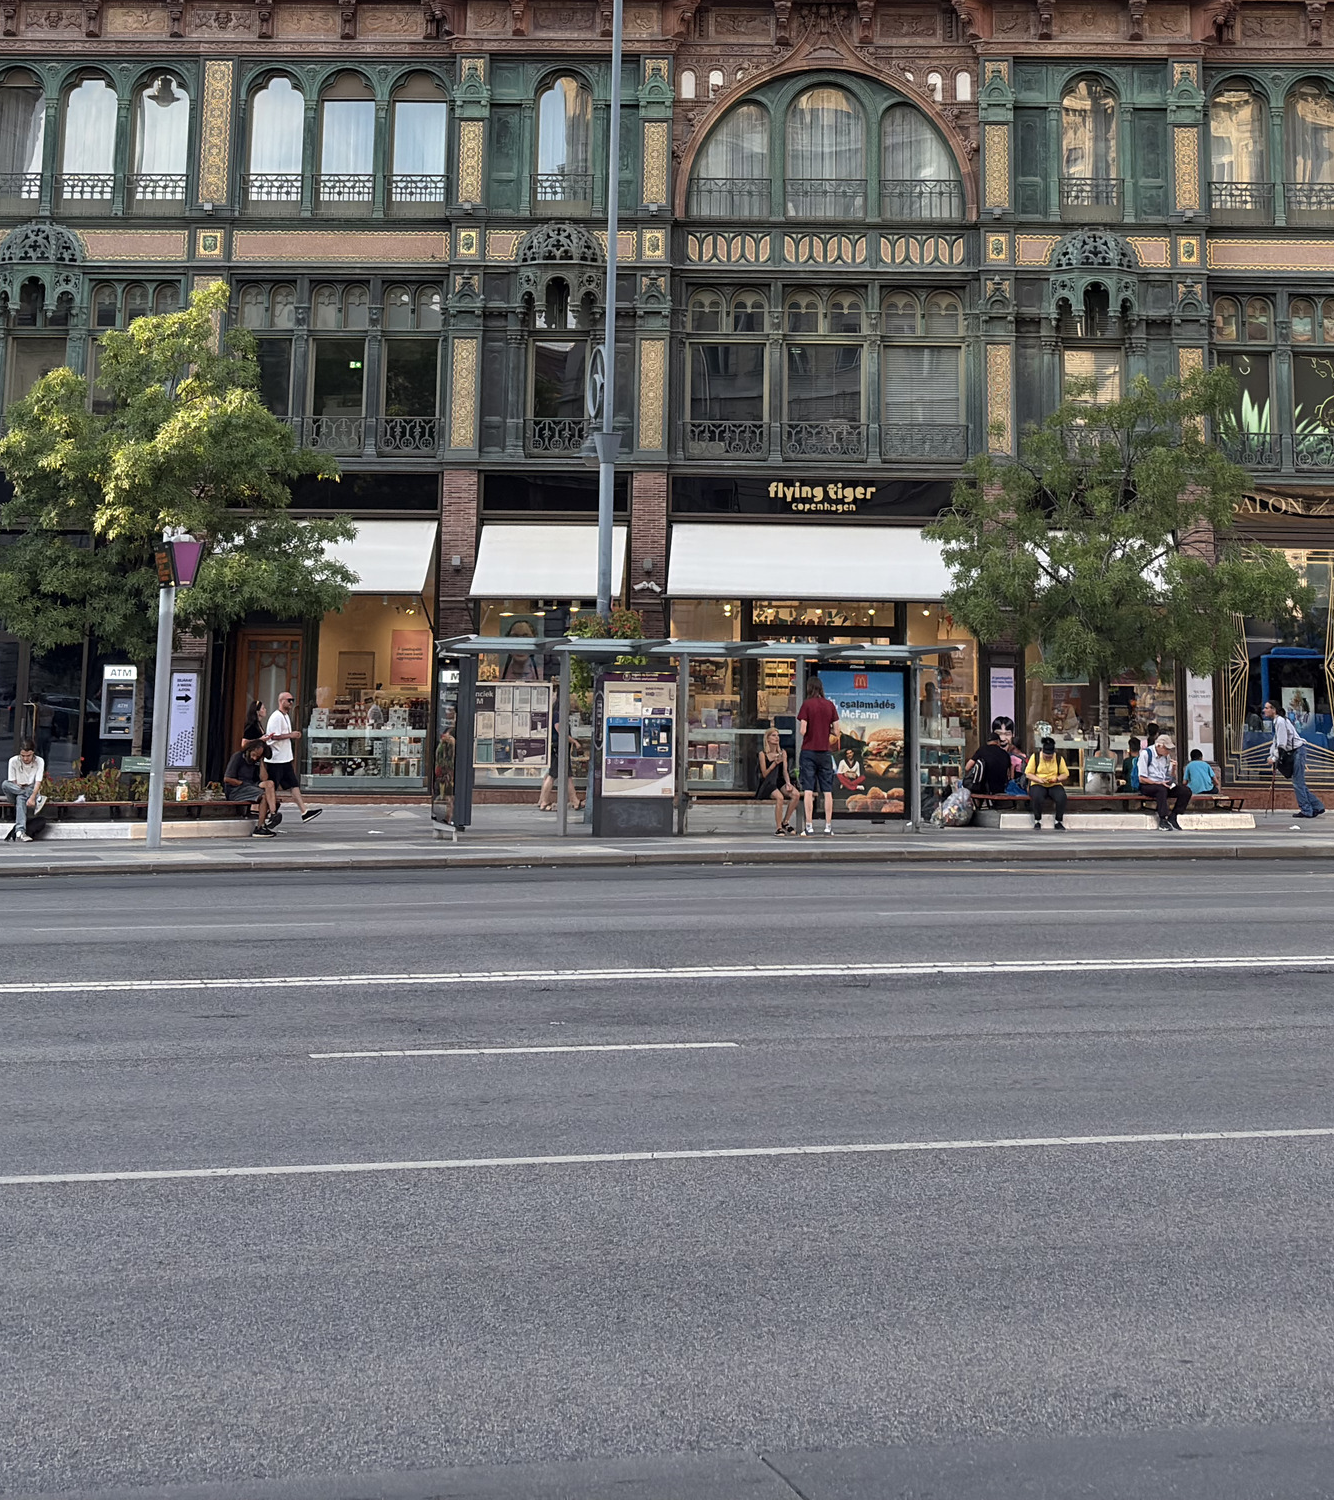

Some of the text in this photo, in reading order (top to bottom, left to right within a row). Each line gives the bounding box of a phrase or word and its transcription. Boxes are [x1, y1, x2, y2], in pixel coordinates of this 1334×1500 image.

[767, 481, 877, 503] flying tiger
[791, 501, 856, 513] copenhagen
[1229, 497, 1303, 514] SALON
[110, 668, 132, 677] ATM
[475, 690, 494, 698] nciek
[839, 700, 896, 710] csalamádés
[841, 709, 879, 719] McFarm
